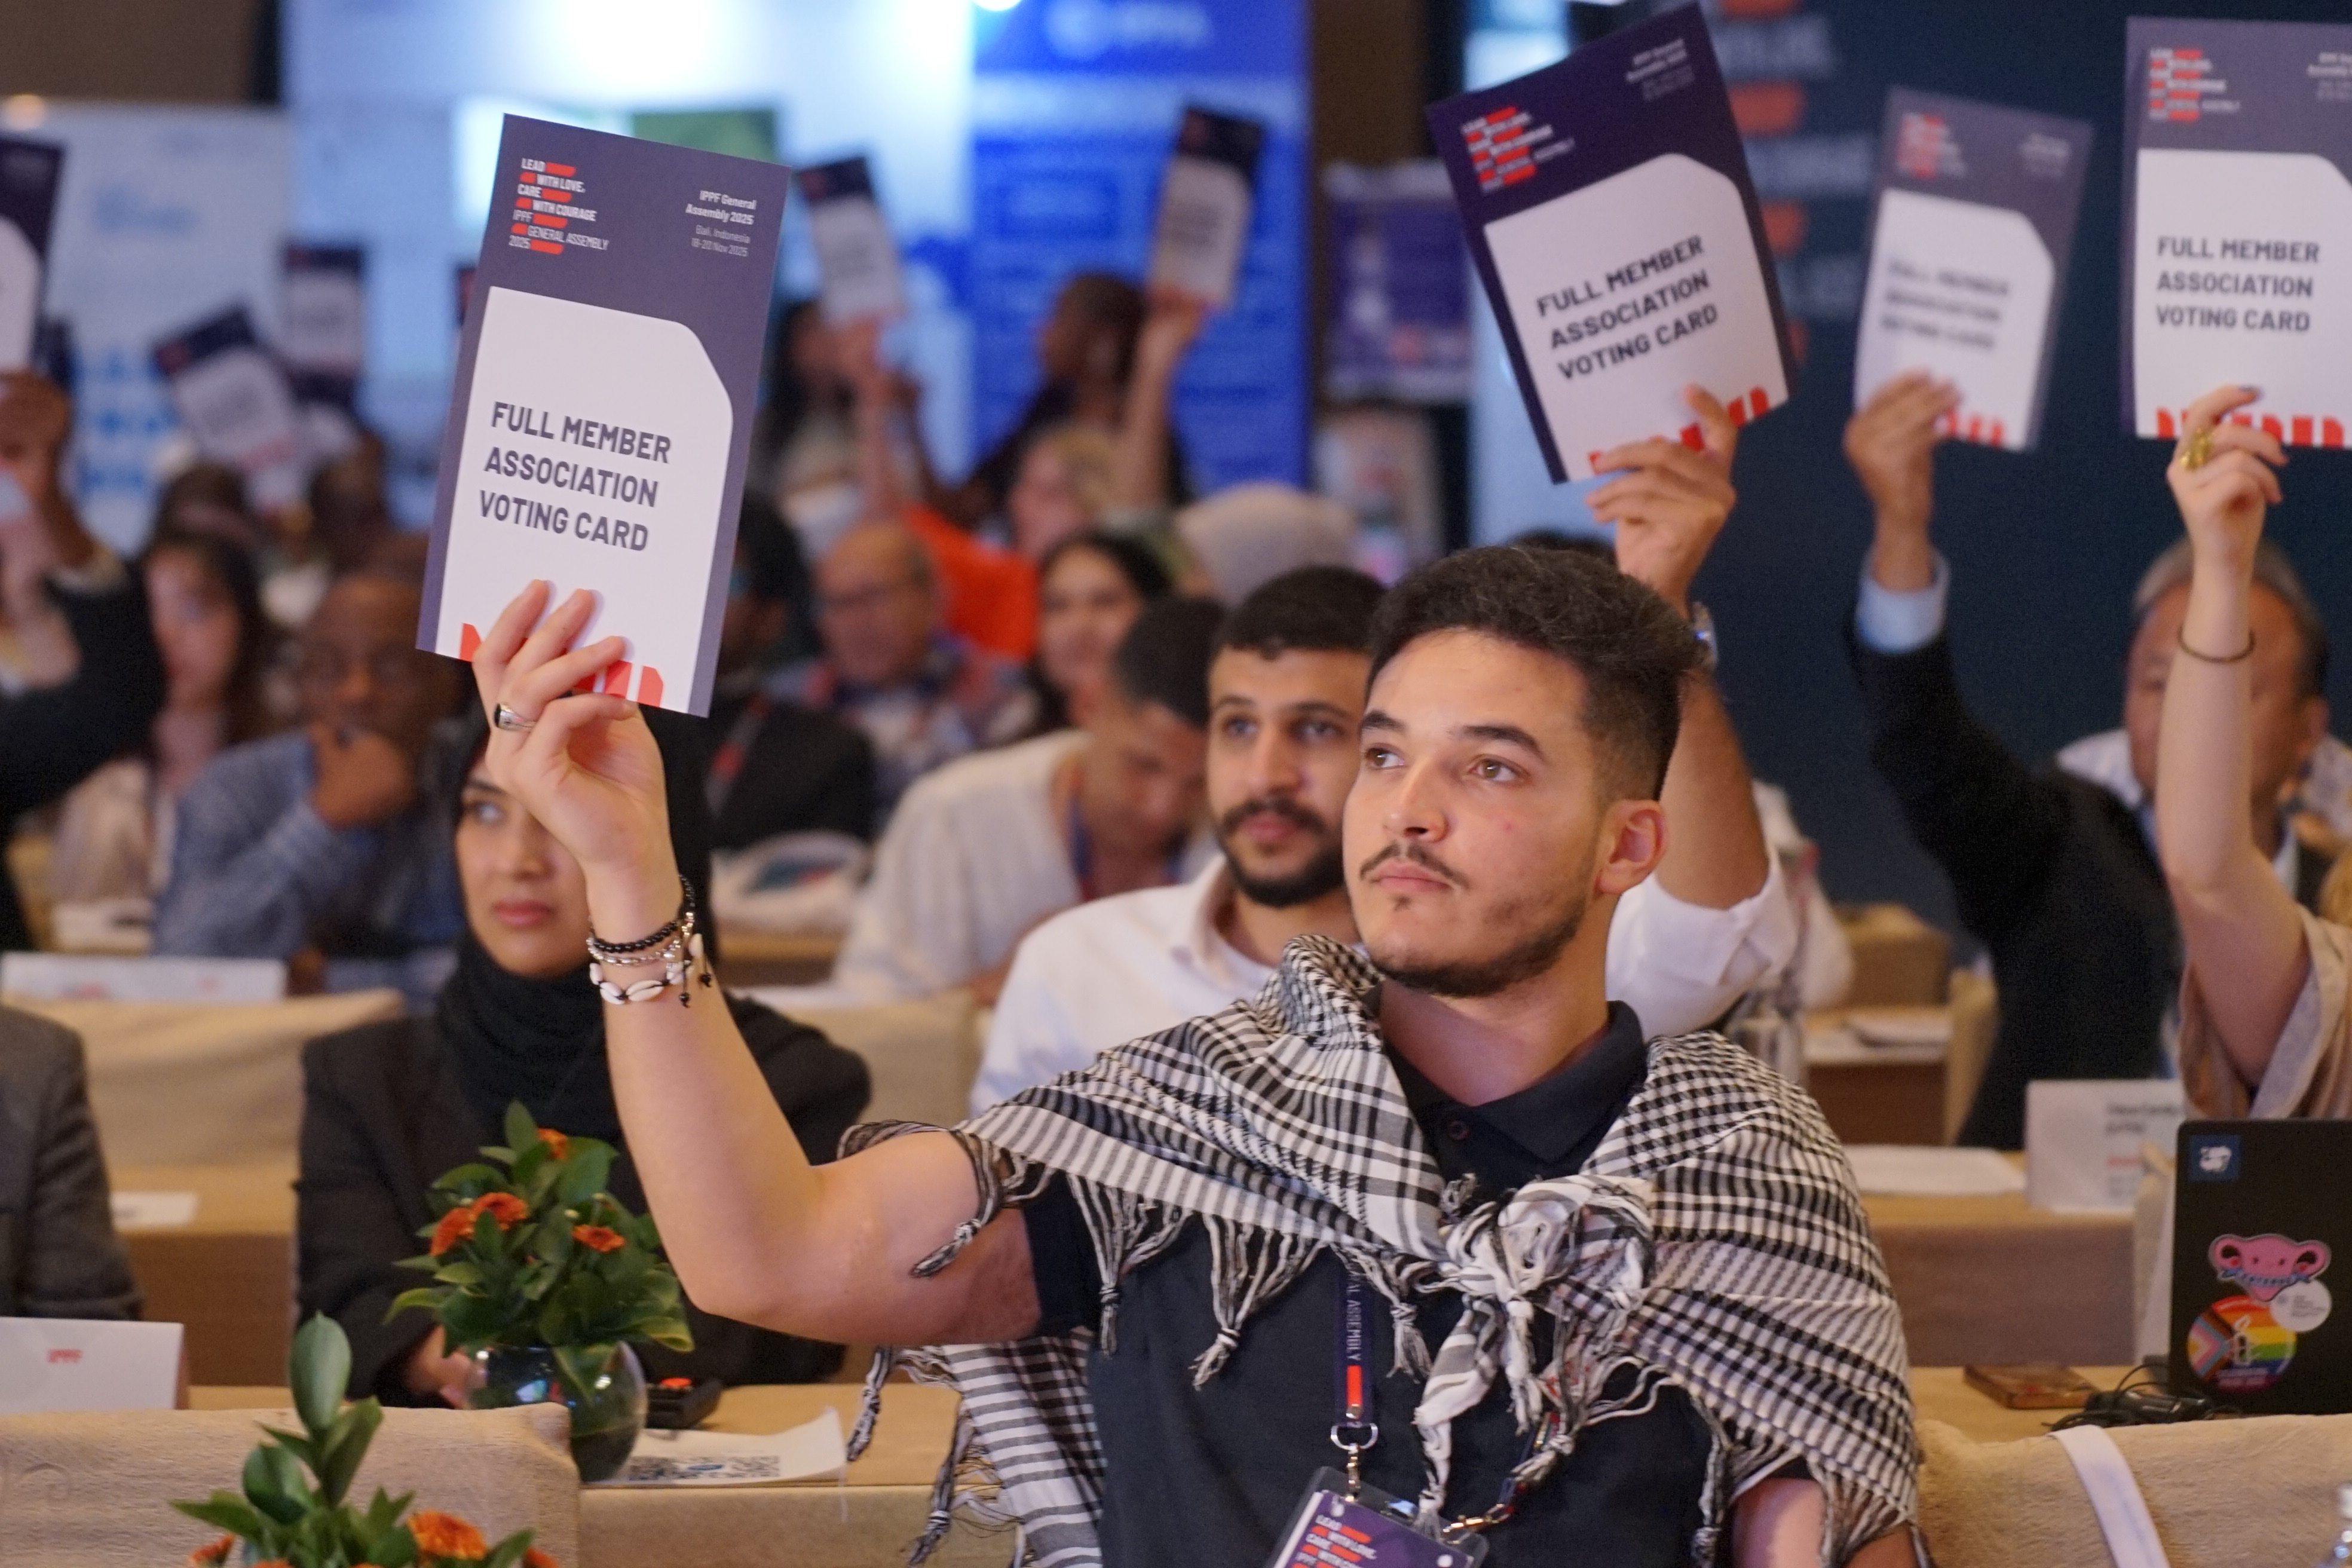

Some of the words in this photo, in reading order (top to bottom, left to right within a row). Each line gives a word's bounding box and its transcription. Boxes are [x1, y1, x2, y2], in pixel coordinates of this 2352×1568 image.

[521, 158, 546, 173] LEAD
[517, 183, 542, 198] CARE
[537, 173, 560, 188] WITH
[532, 200, 556, 214] WITH
[556, 204, 598, 222] COURAGE
[699, 190, 721, 203] IPPF
[721, 194, 757, 210] General
[513, 209, 534, 223] IPPF
[685, 203, 730, 223] Assembly
[730, 212, 755, 225] 2025
[509, 235, 531, 250] 2025
[527, 225, 565, 243] GENERAL
[565, 232, 610, 251] ASSEMBLY
[2157, 236, 2214, 259] FULL
[2219, 237, 2320, 264] MEMBER
[1536, 278, 1603, 318] FULL
[1605, 234, 1704, 293] MEMBER
[2156, 270, 2313, 298] ASSOCIATION
[1551, 269, 1710, 350] ASSOCIATION
[2156, 304, 2237, 329] VOTING
[2243, 308, 2311, 332] CARD
[1557, 333, 1651, 381] VOTING
[1655, 302, 1719, 347] CARD
[491, 401, 555, 440] FULL
[562, 416, 672, 464] MEMBER
[483, 446, 659, 508] ASSOCIATION
[479, 489, 569, 534] VOTING
[574, 512, 650, 552] CARD
